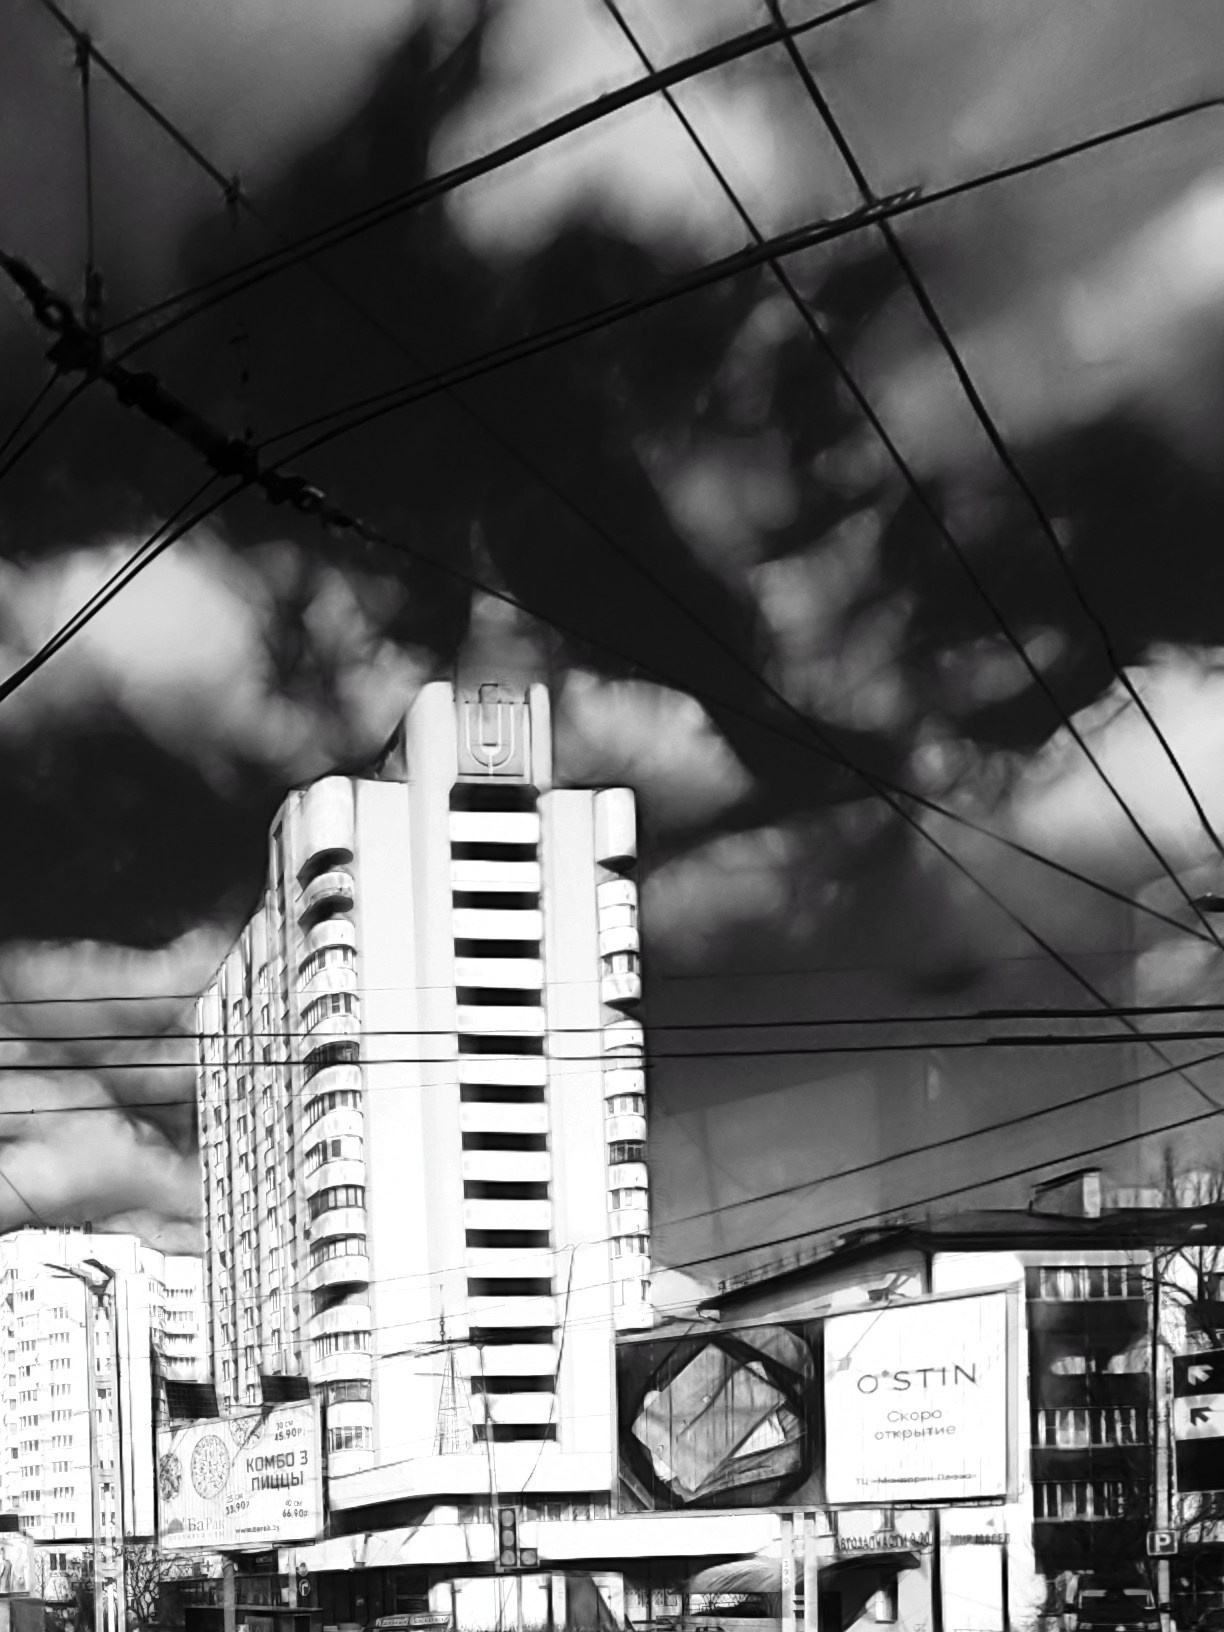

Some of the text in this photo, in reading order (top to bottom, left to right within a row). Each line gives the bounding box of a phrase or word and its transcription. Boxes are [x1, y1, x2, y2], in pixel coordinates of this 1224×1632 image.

[857, 1363, 976, 1394] O'STIN
[887, 1409, 942, 1423] Скоро
[875, 1425, 956, 1440] открытие
[246, 1450, 308, 1473] КОМБО 3
[251, 1471, 304, 1491] ПИЦЦЫ
[1155, 1533, 1171, 1552] P
